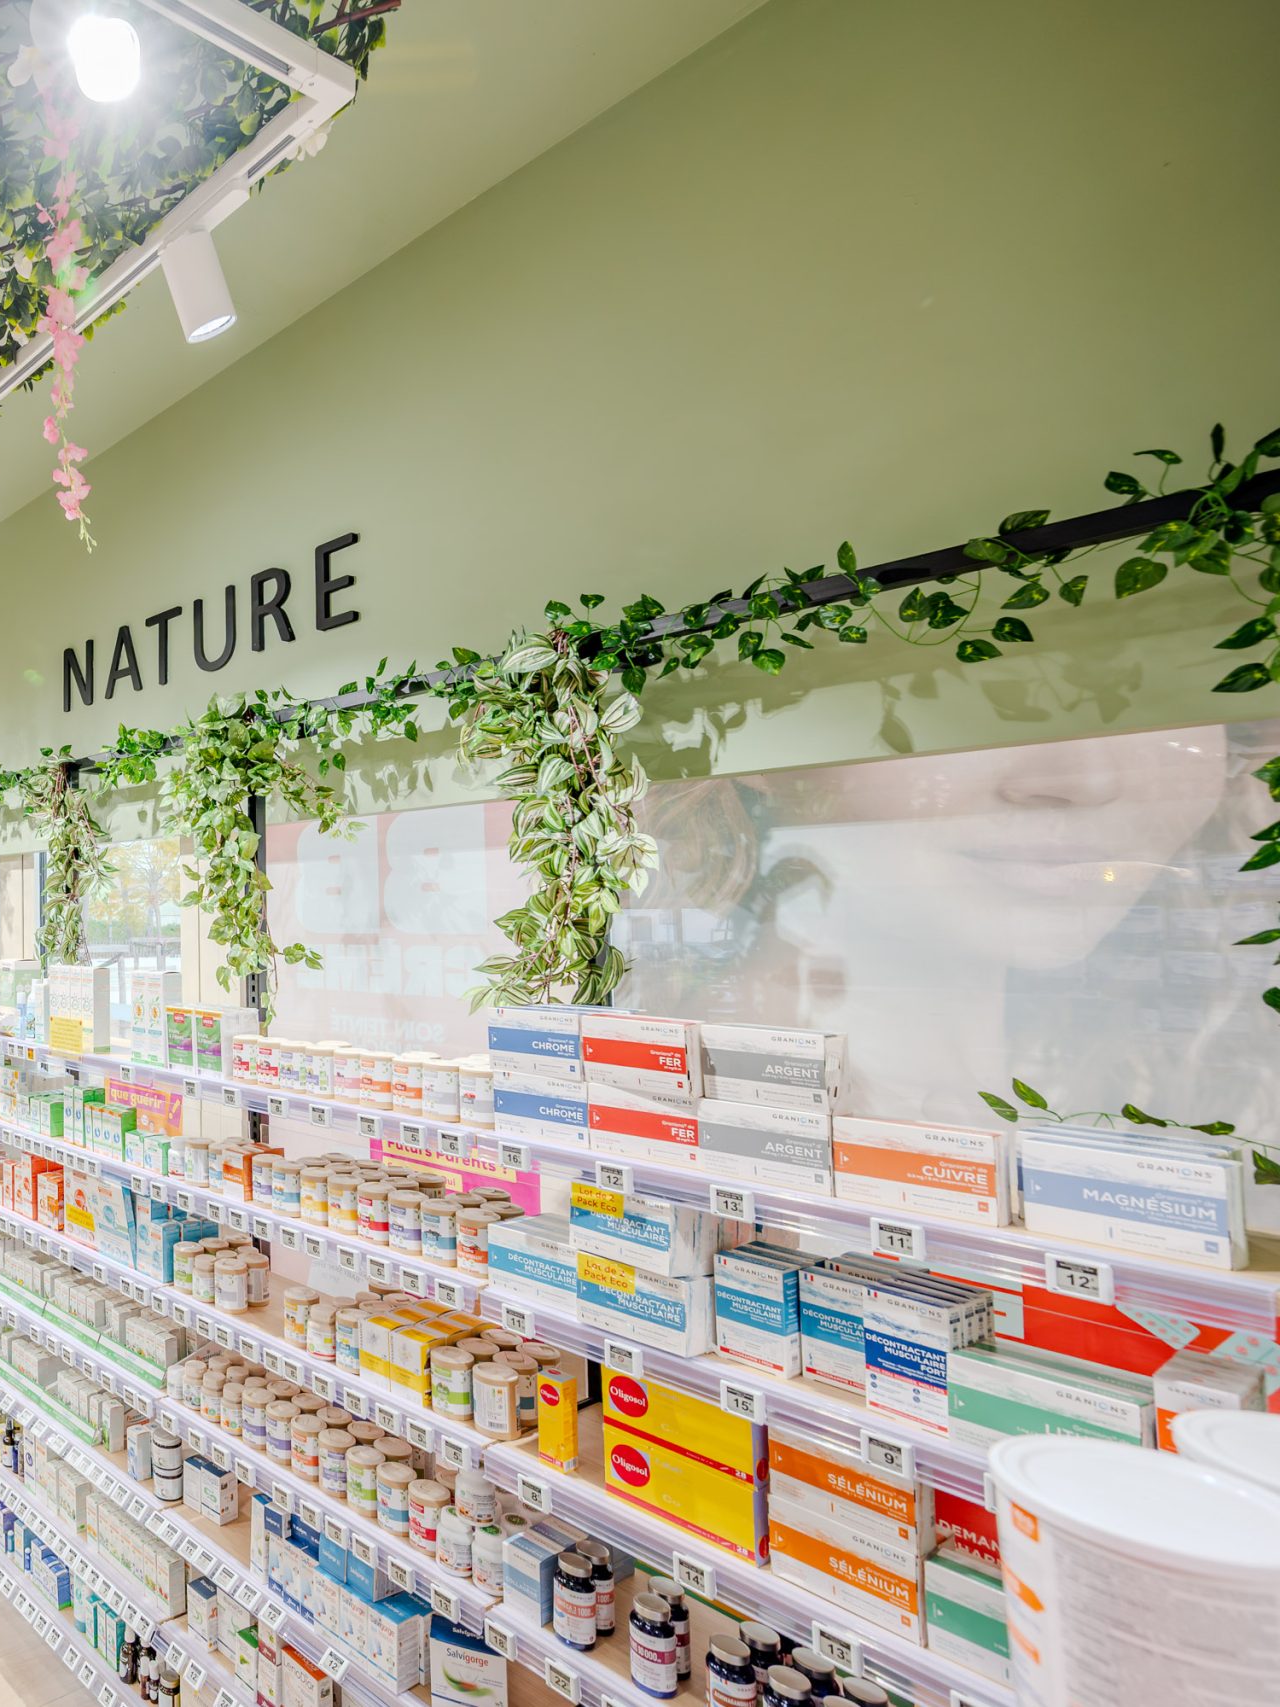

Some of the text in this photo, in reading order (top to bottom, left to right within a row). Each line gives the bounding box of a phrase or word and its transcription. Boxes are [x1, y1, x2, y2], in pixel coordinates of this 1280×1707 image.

[62, 532, 361, 713] NATURE
[532, 1041, 575, 1053] CHROME
[659, 1056, 682, 1067] FER
[765, 1064, 820, 1079] ARGENT
[110, 1088, 163, 1110] que guérir
[539, 1106, 584, 1121] CHROME
[772, 1113, 820, 1125] GRANIONS
[671, 1128, 695, 1140] FER
[924, 1134, 985, 1147] GRANIONS
[765, 1142, 823, 1159] ARGENT
[507, 1154, 519, 1164] 16
[922, 1166, 988, 1186] CUIVRE
[1136, 1162, 1213, 1179] GRANIONS
[606, 1174, 620, 1186] 12
[579, 1187, 593, 1197] Lot
[577, 1196, 618, 1214] Pack Eco
[723, 1199, 739, 1212] 13
[1082, 1188, 1217, 1222] MAGNÉSIUM
[607, 1222, 667, 1244] MUSCULAIRE
[887, 1234, 905, 1250] 11
[508, 1252, 577, 1279] DÉCONTRACTANT
[734, 1265, 778, 1282] GRANIONS
[524, 1265, 577, 1286] MUSCULAIRE
[584, 1268, 628, 1289] Pack Eco
[1067, 1273, 1090, 1288] 12
[446, 1292, 452, 1301] 5
[822, 1281, 863, 1297] GRANIO
[617, 1296, 682, 1323] MUSCULAIRE
[716, 1290, 782, 1314] DÉCONTRACTANT
[886, 1298, 943, 1319] GRANIONS
[732, 1301, 782, 1321] MUSCULAIRE
[802, 1308, 864, 1330] DÉCONTRACTA
[511, 1316, 521, 1328] 11
[819, 1320, 864, 1337] MUSCULAI
[866, 1332, 946, 1363] DÉCONTRACTANT
[884, 1346, 946, 1370] MUSCULAIRE
[920, 1365, 947, 1378] FORT
[540, 1388, 560, 1401] Oligosol
[609, 1386, 646, 1408] Oligosol
[734, 1398, 749, 1411] 15
[1056, 1390, 1128, 1416] GRANIONS
[611, 1454, 648, 1478] Oligosol
[884, 1452, 895, 1465] 9
[734, 1469, 747, 1480] 28
[828, 1472, 907, 1513] SÉLÉNIUM
[938, 1519, 1001, 1553] DEMAN
[685, 1571, 700, 1585] 14
[828, 1556, 910, 1602] SÉLÉNIUM
[438, 1599, 449, 1612] 13
[267, 1610, 277, 1621] 12
[493, 1636, 505, 1649] 18
[446, 1648, 489, 1668] Salvigorge
[828, 1644, 845, 1660] 13
[328, 1660, 338, 1671] 12
[554, 1676, 567, 1689] 22
